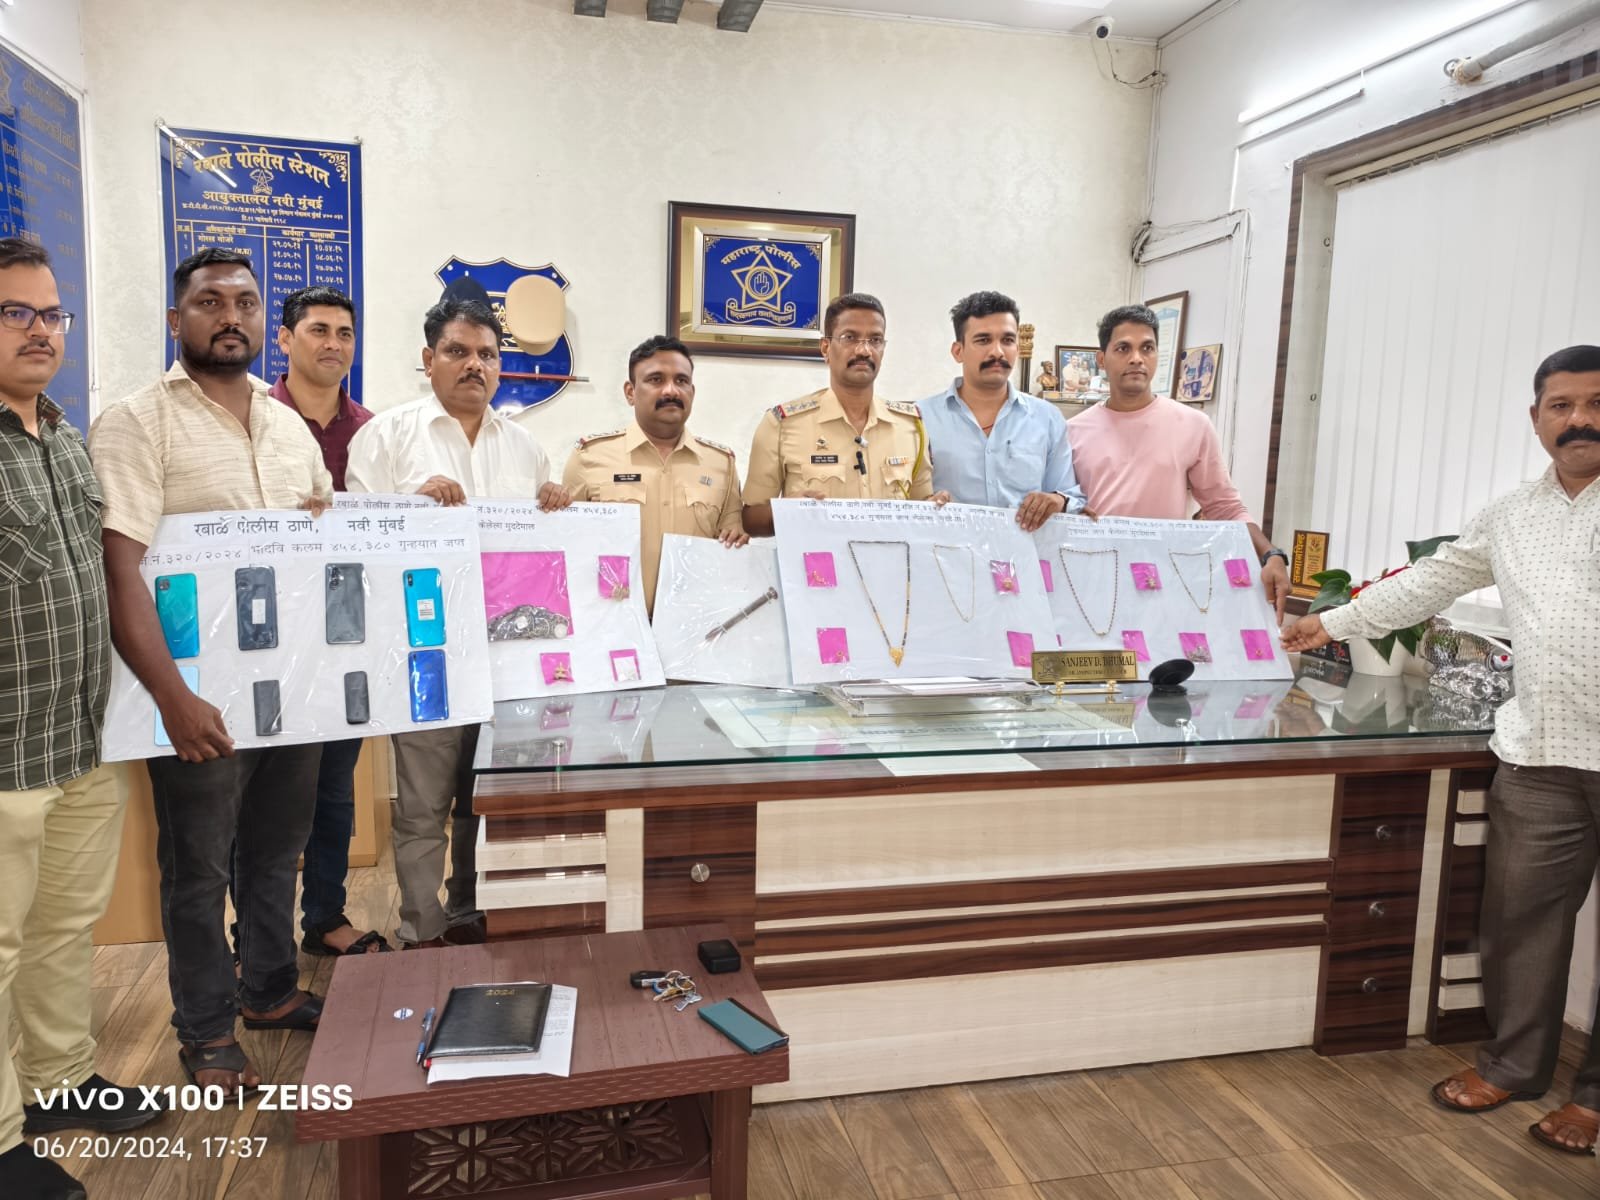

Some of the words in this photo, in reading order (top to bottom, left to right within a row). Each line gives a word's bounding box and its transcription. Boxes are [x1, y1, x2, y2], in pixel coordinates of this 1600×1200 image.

[236, 146, 285, 171] पोलीस
[287, 152, 330, 188] स्टेशन
[203, 191, 269, 205] आयुक्तालय
[272, 193, 294, 207] नवी
[297, 195, 323, 210] मुंबई
[765, 244, 802, 269] पोलीस
[194, 516, 229, 537] रबाळे
[237, 516, 279, 535] पोलीस
[287, 516, 319, 534] ठाणे,
[347, 516, 371, 532] नवी
[378, 515, 406, 535] मुंबई
[291, 543, 322, 553] कलम
[1061, 656, 1093, 668] SANJEEV
[1102, 655, 1134, 667] DHUMAL
